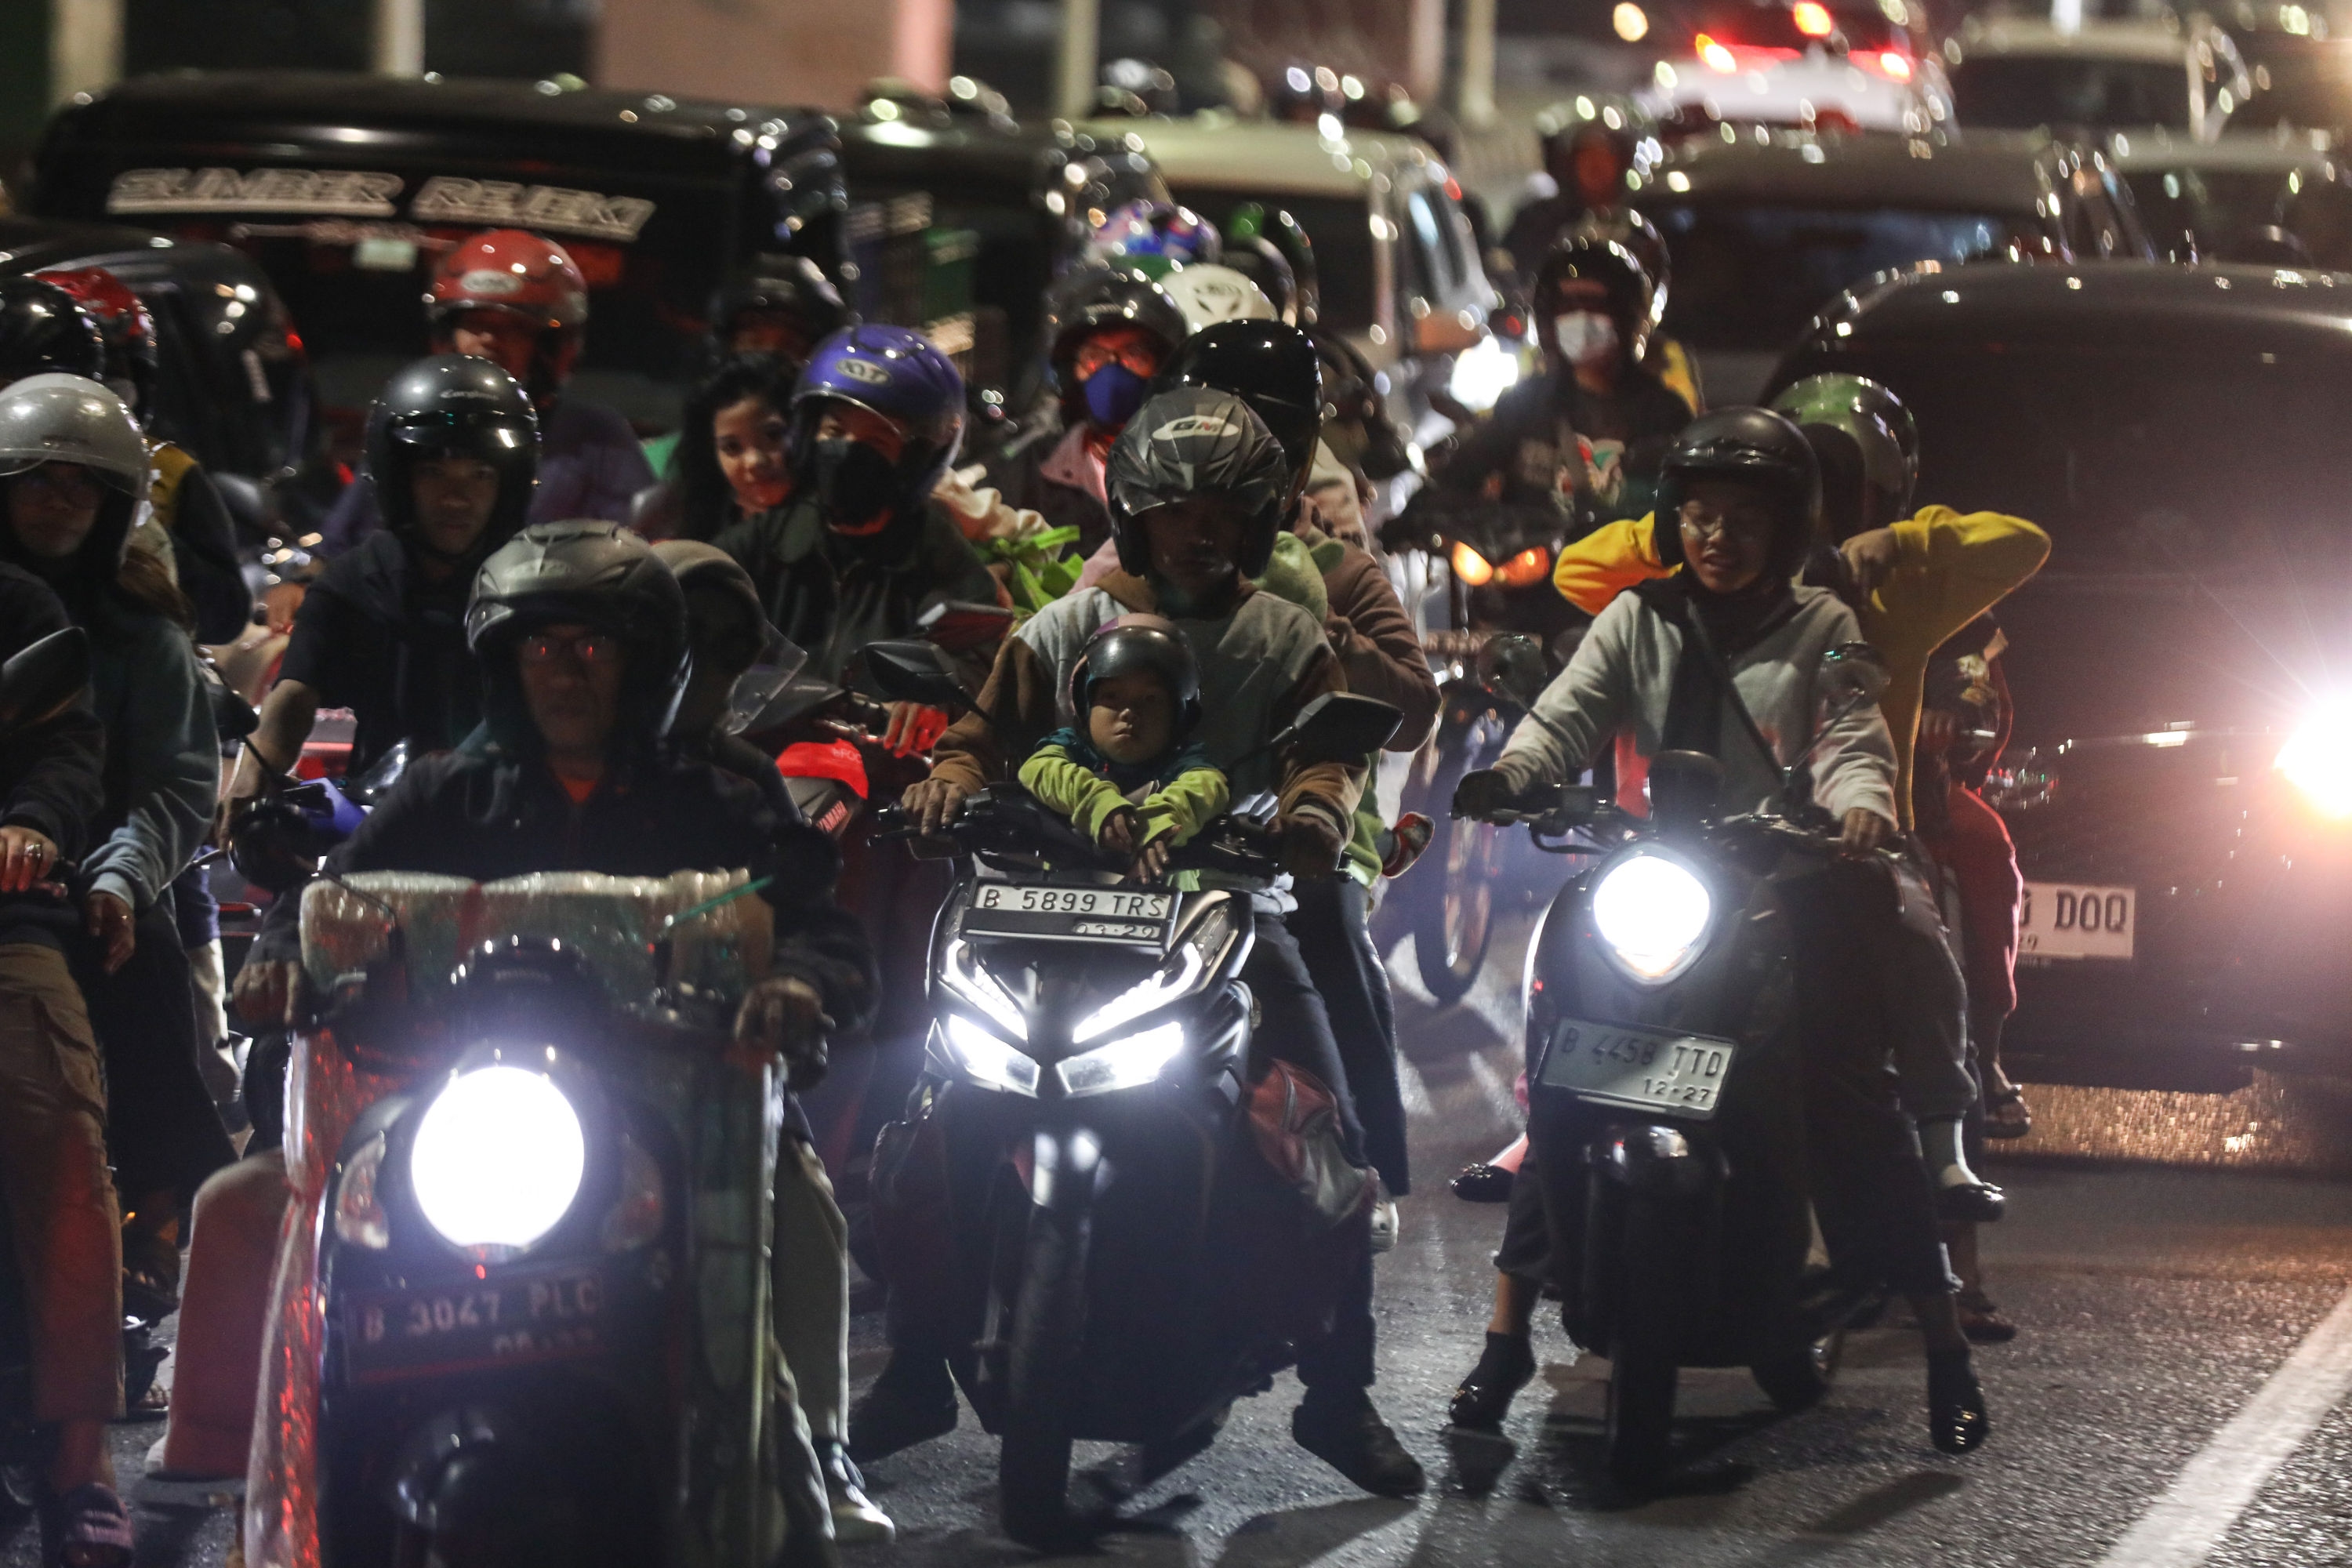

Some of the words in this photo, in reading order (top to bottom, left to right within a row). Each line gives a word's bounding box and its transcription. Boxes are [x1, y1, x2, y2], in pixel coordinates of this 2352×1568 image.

[983, 888, 1000, 909] B
[1022, 890, 1097, 913] 5899
[1112, 895, 1165, 917] TRS
[2055, 888, 2126, 932] DOQ
[1561, 1027, 1581, 1054] B
